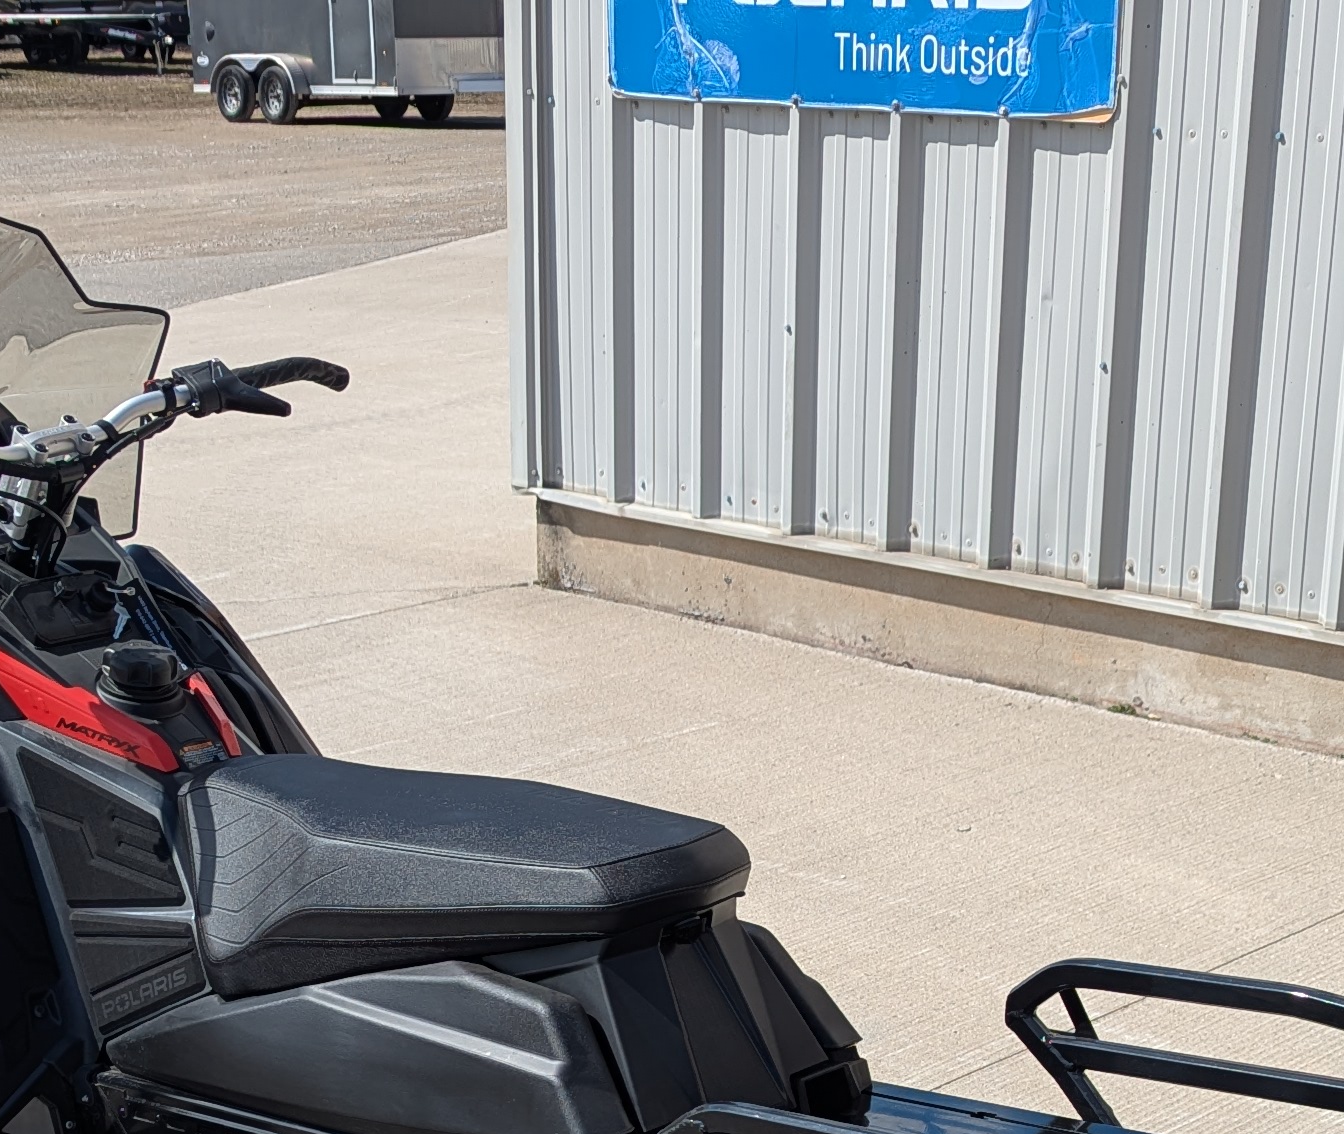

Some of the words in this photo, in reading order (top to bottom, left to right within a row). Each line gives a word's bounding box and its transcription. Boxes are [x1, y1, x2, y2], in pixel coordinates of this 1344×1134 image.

[834, 32, 910, 73] Think
[920, 34, 1031, 77] Outside
[56, 718, 141, 759] MATRYX
[101, 966, 188, 1018] POLARIS
